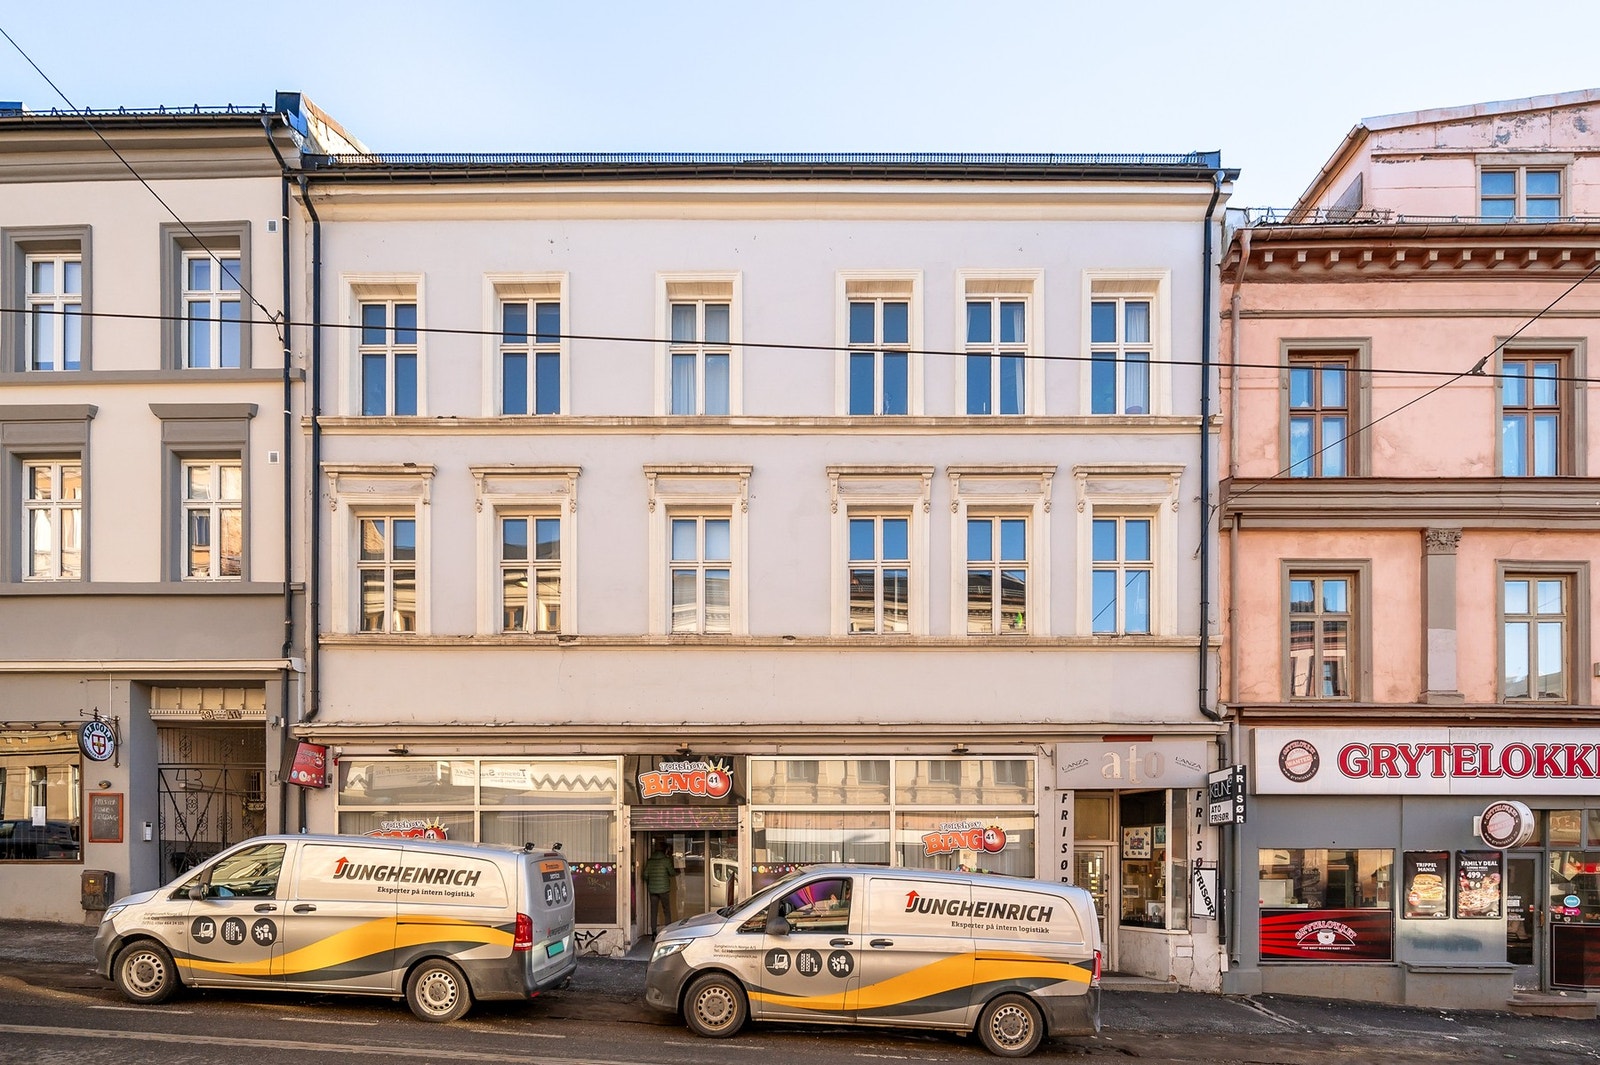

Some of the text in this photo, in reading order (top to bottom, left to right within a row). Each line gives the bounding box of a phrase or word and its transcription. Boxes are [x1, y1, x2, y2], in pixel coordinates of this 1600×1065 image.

[84, 723, 112, 742] LINCOLN
[1101, 744, 1164, 784] ato
[1337, 743, 1600, 778] GRYTELOKK
[640, 769, 731, 798] BINGO
[709, 776, 719, 784] 41
[1236, 764, 1245, 823] FRISØR
[1211, 804, 1221, 813] ATO
[1211, 812, 1230, 821] FRISØR
[923, 828, 1006, 854] BINGO
[333, 863, 482, 887] JUNGHEINRICH
[377, 886, 475, 898] Eksperter på intern logistikk
[1194, 868, 1217, 917] FRISØR
[905, 897, 1054, 923] JUNGHEINRICH
[951, 920, 1050, 934] Eksperter på intern logistikk
[1295, 920, 1358, 940] GRYTELOKKET
